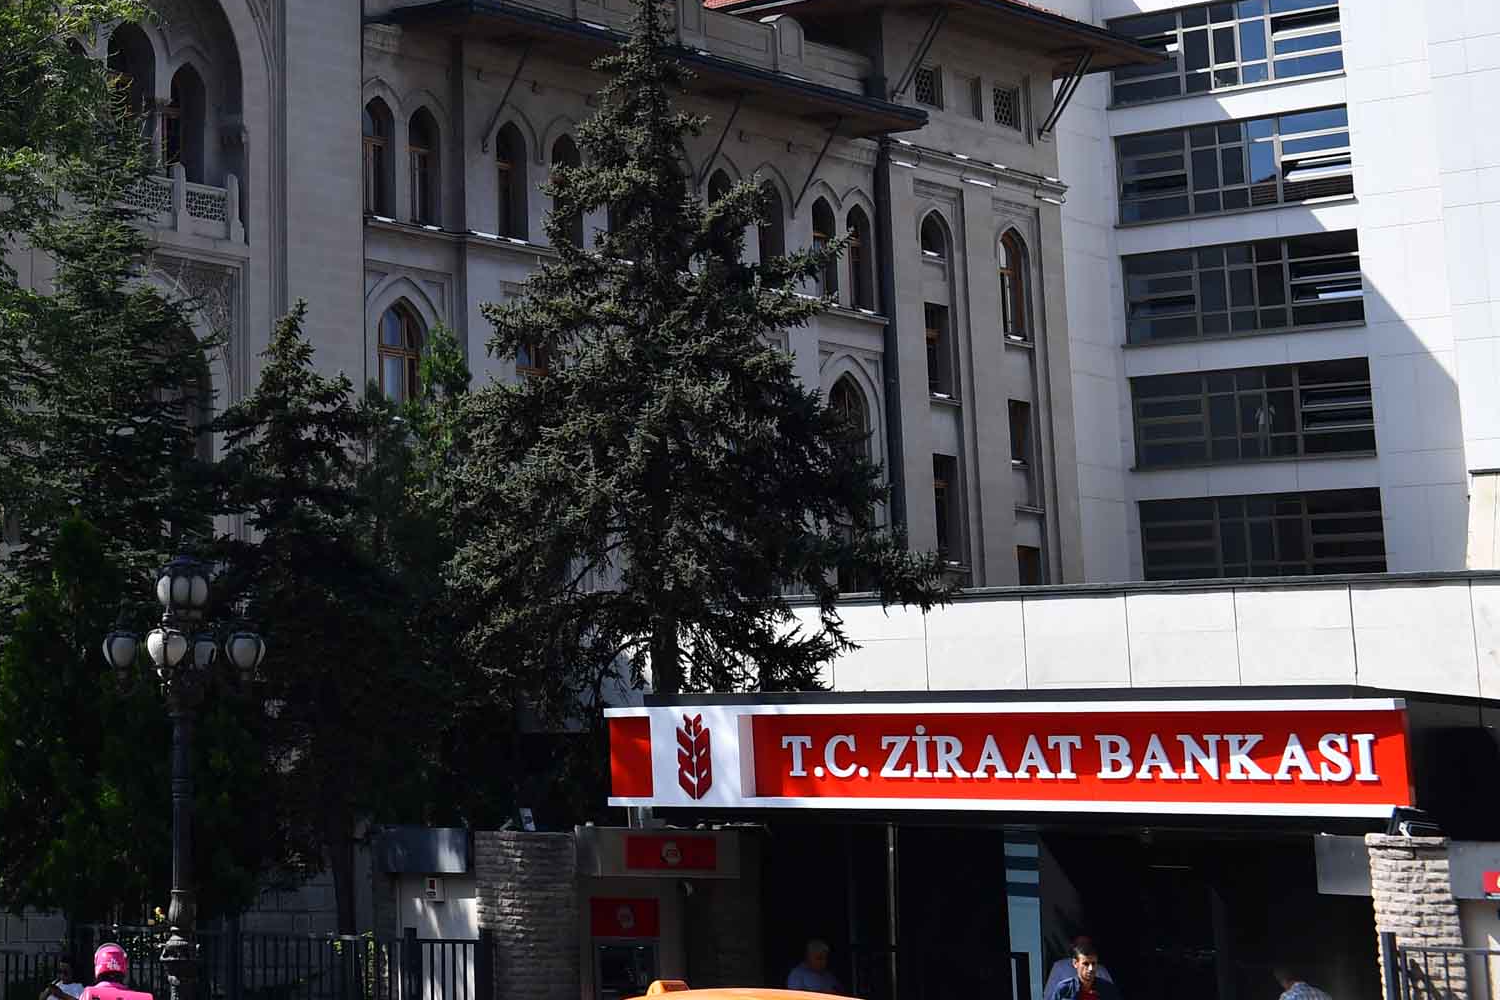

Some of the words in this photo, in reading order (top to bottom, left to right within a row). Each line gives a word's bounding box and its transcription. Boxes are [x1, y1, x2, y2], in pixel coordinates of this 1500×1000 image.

[782, 734, 869, 777] T.C.
[879, 725, 1082, 779] ZİRAAT
[1095, 733, 1379, 781] BANKASI
